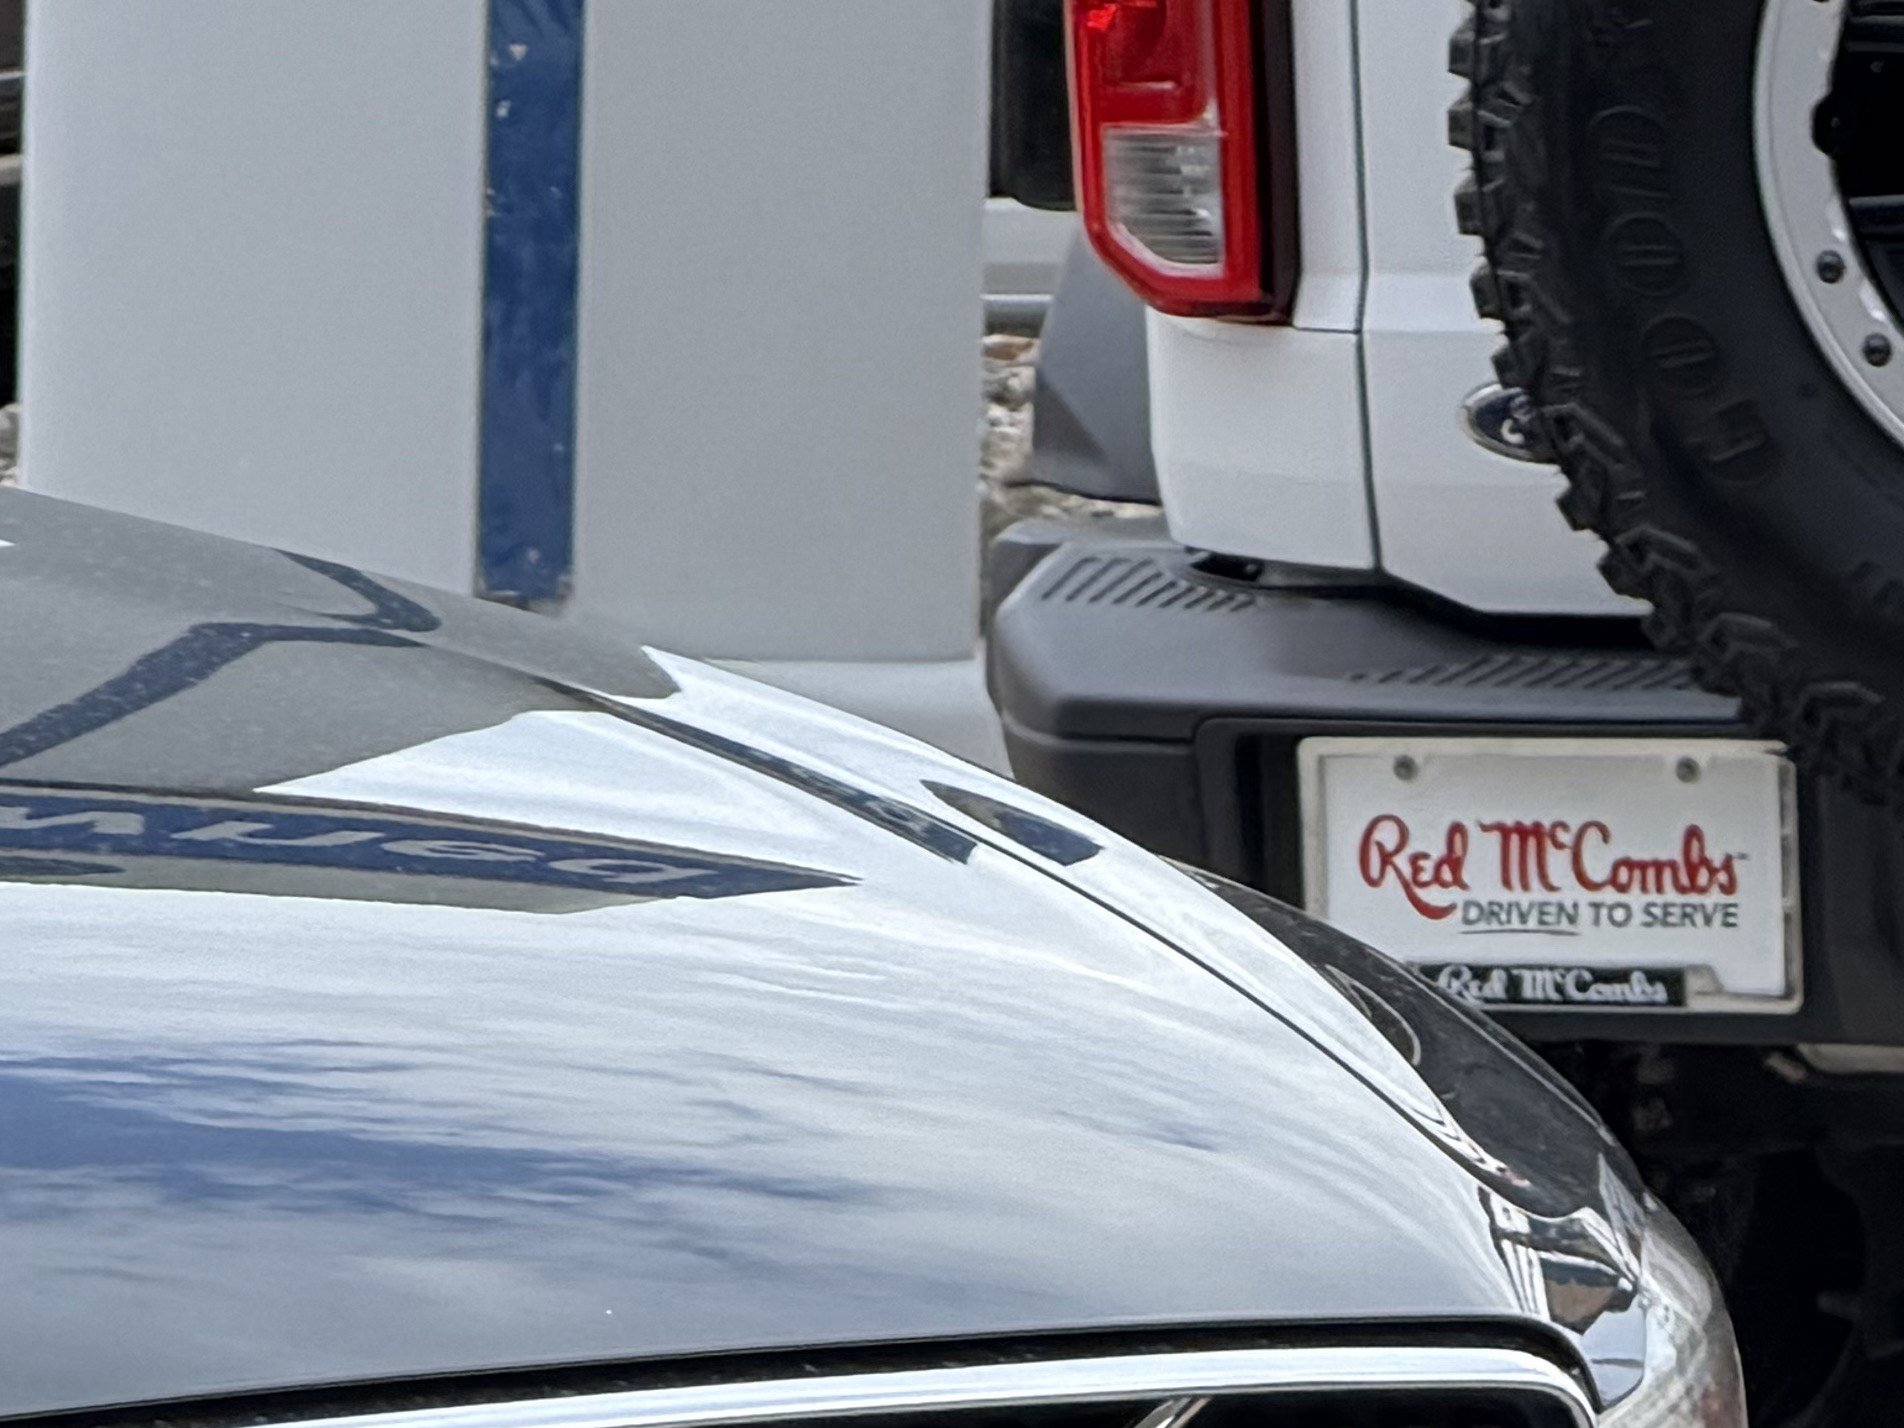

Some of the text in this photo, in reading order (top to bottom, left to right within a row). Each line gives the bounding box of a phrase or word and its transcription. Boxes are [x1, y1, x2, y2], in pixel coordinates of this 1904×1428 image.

[1359, 813, 1738, 919] Red McCombs
[1461, 901, 1739, 929] DRIVEN TO SERVE
[1438, 964, 1668, 1005] Red McCombs
